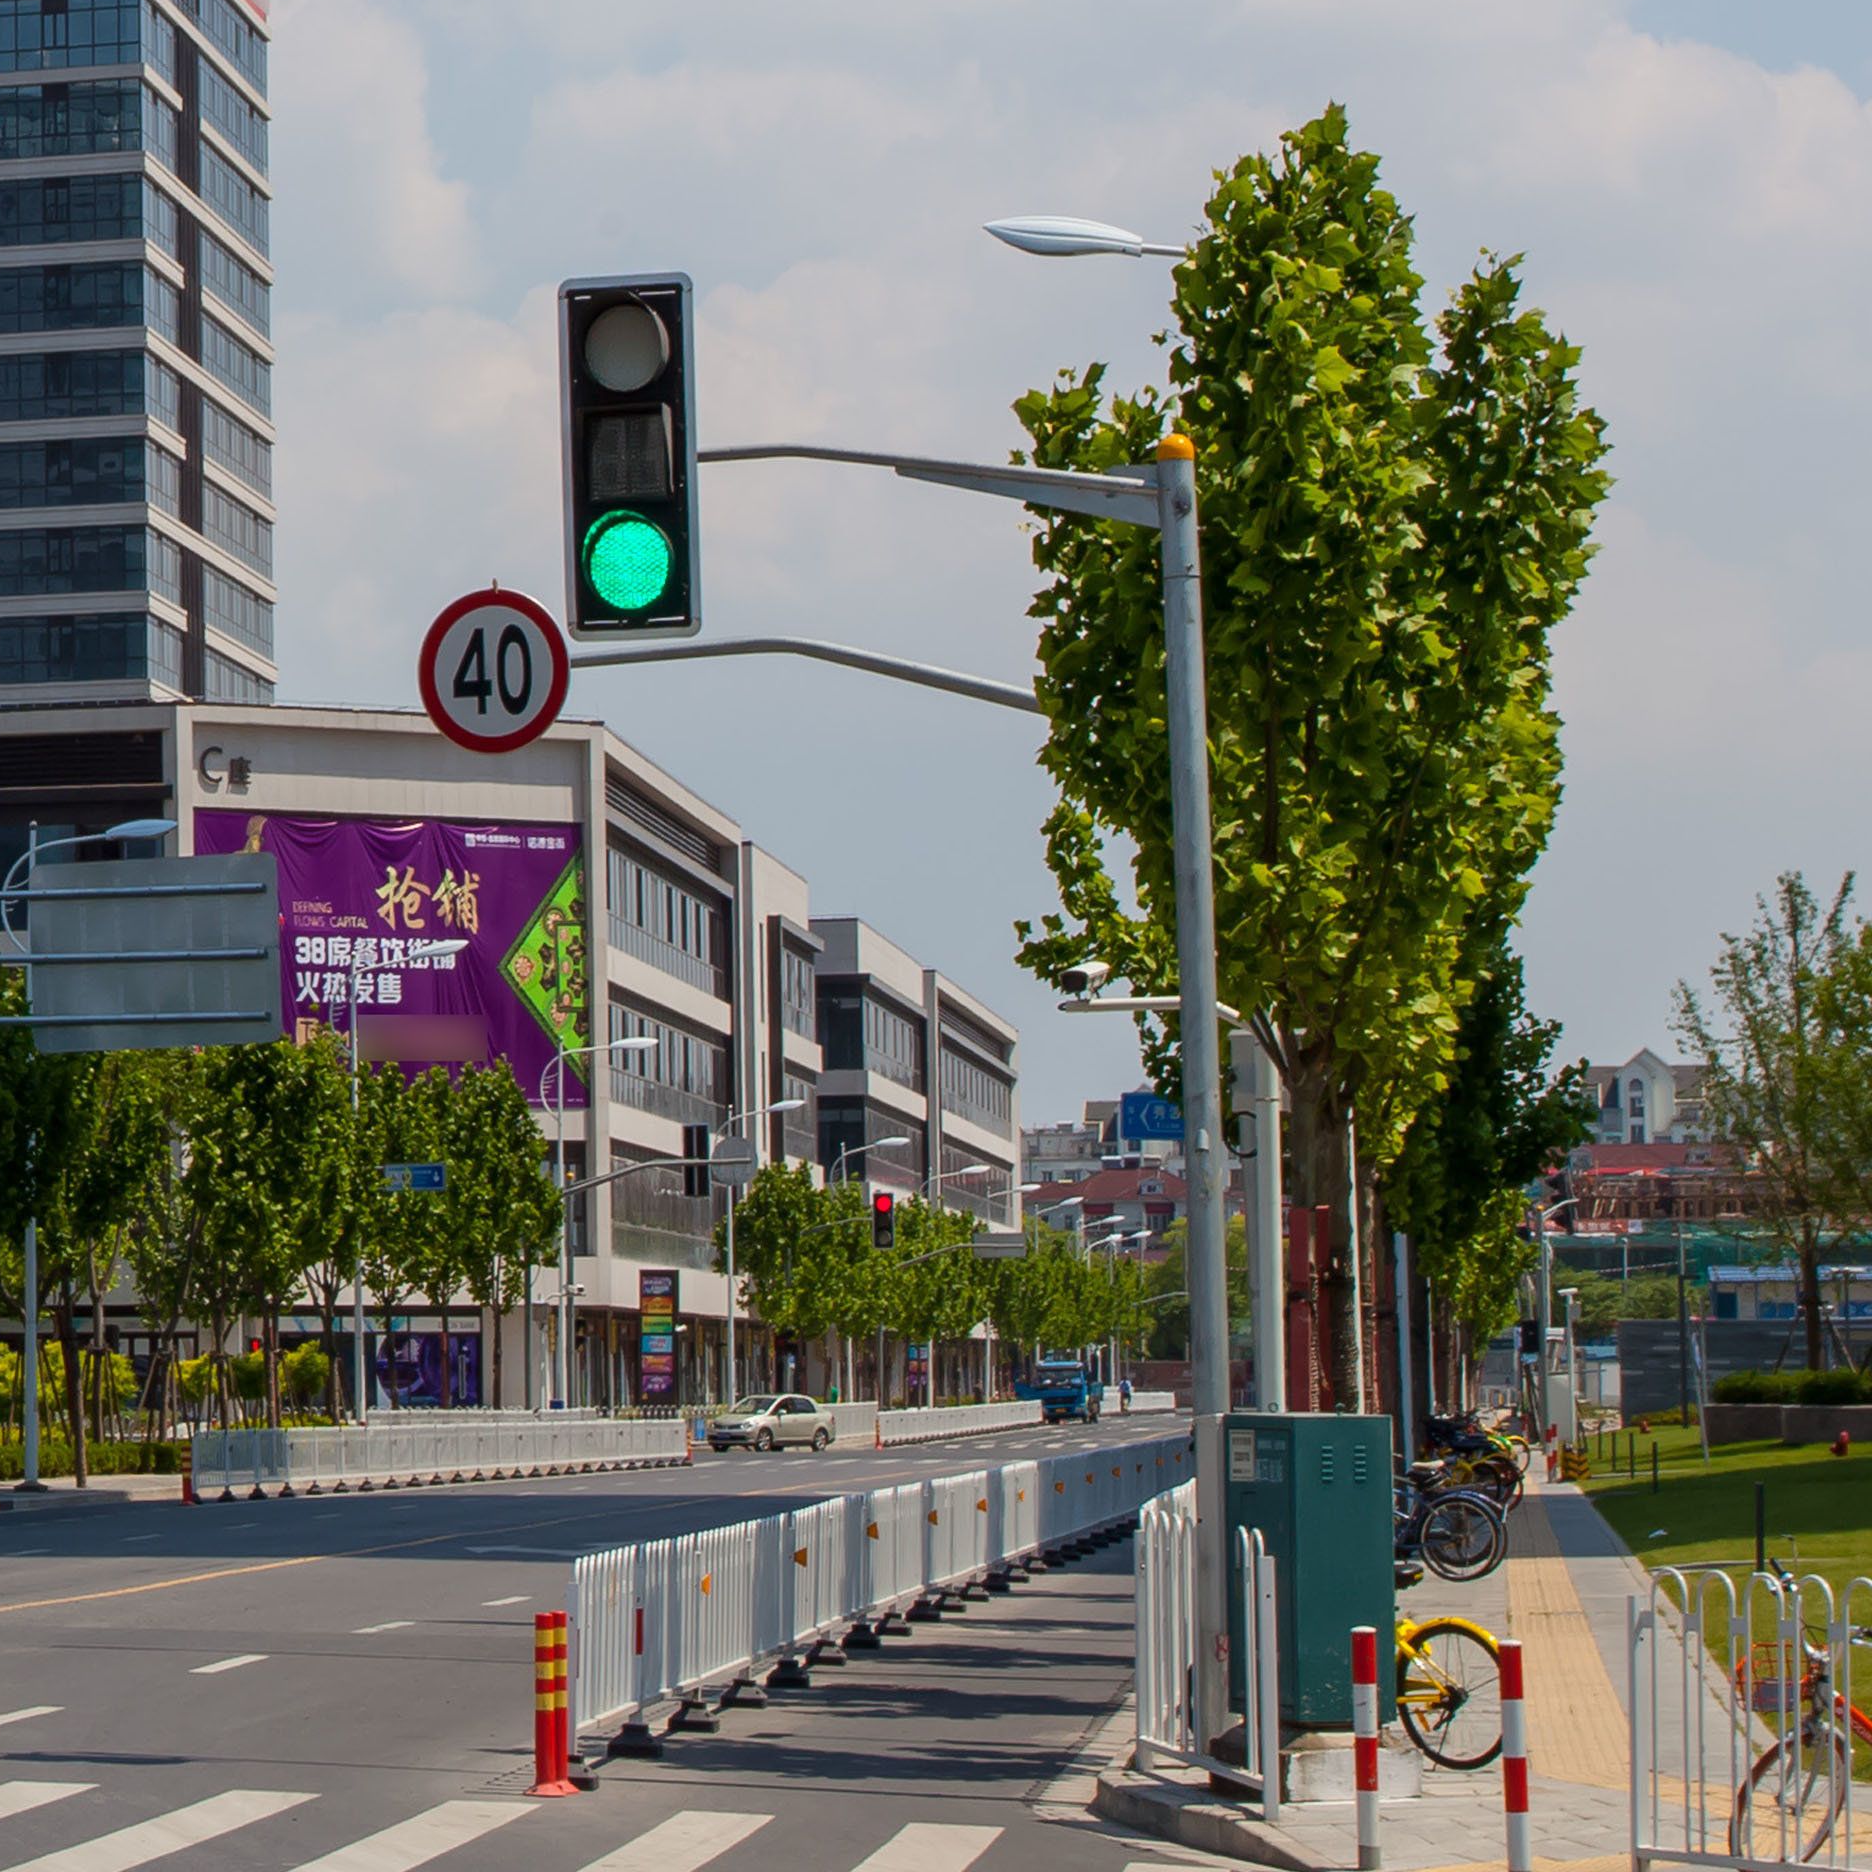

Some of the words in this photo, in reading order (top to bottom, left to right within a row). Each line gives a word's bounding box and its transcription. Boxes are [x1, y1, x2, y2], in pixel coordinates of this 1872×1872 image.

[453, 624, 533, 716] 40
[329, 915, 369, 929] CAPITAL
[375, 866, 481, 935] 抢铺
[294, 971, 403, 1004] 火热发售
